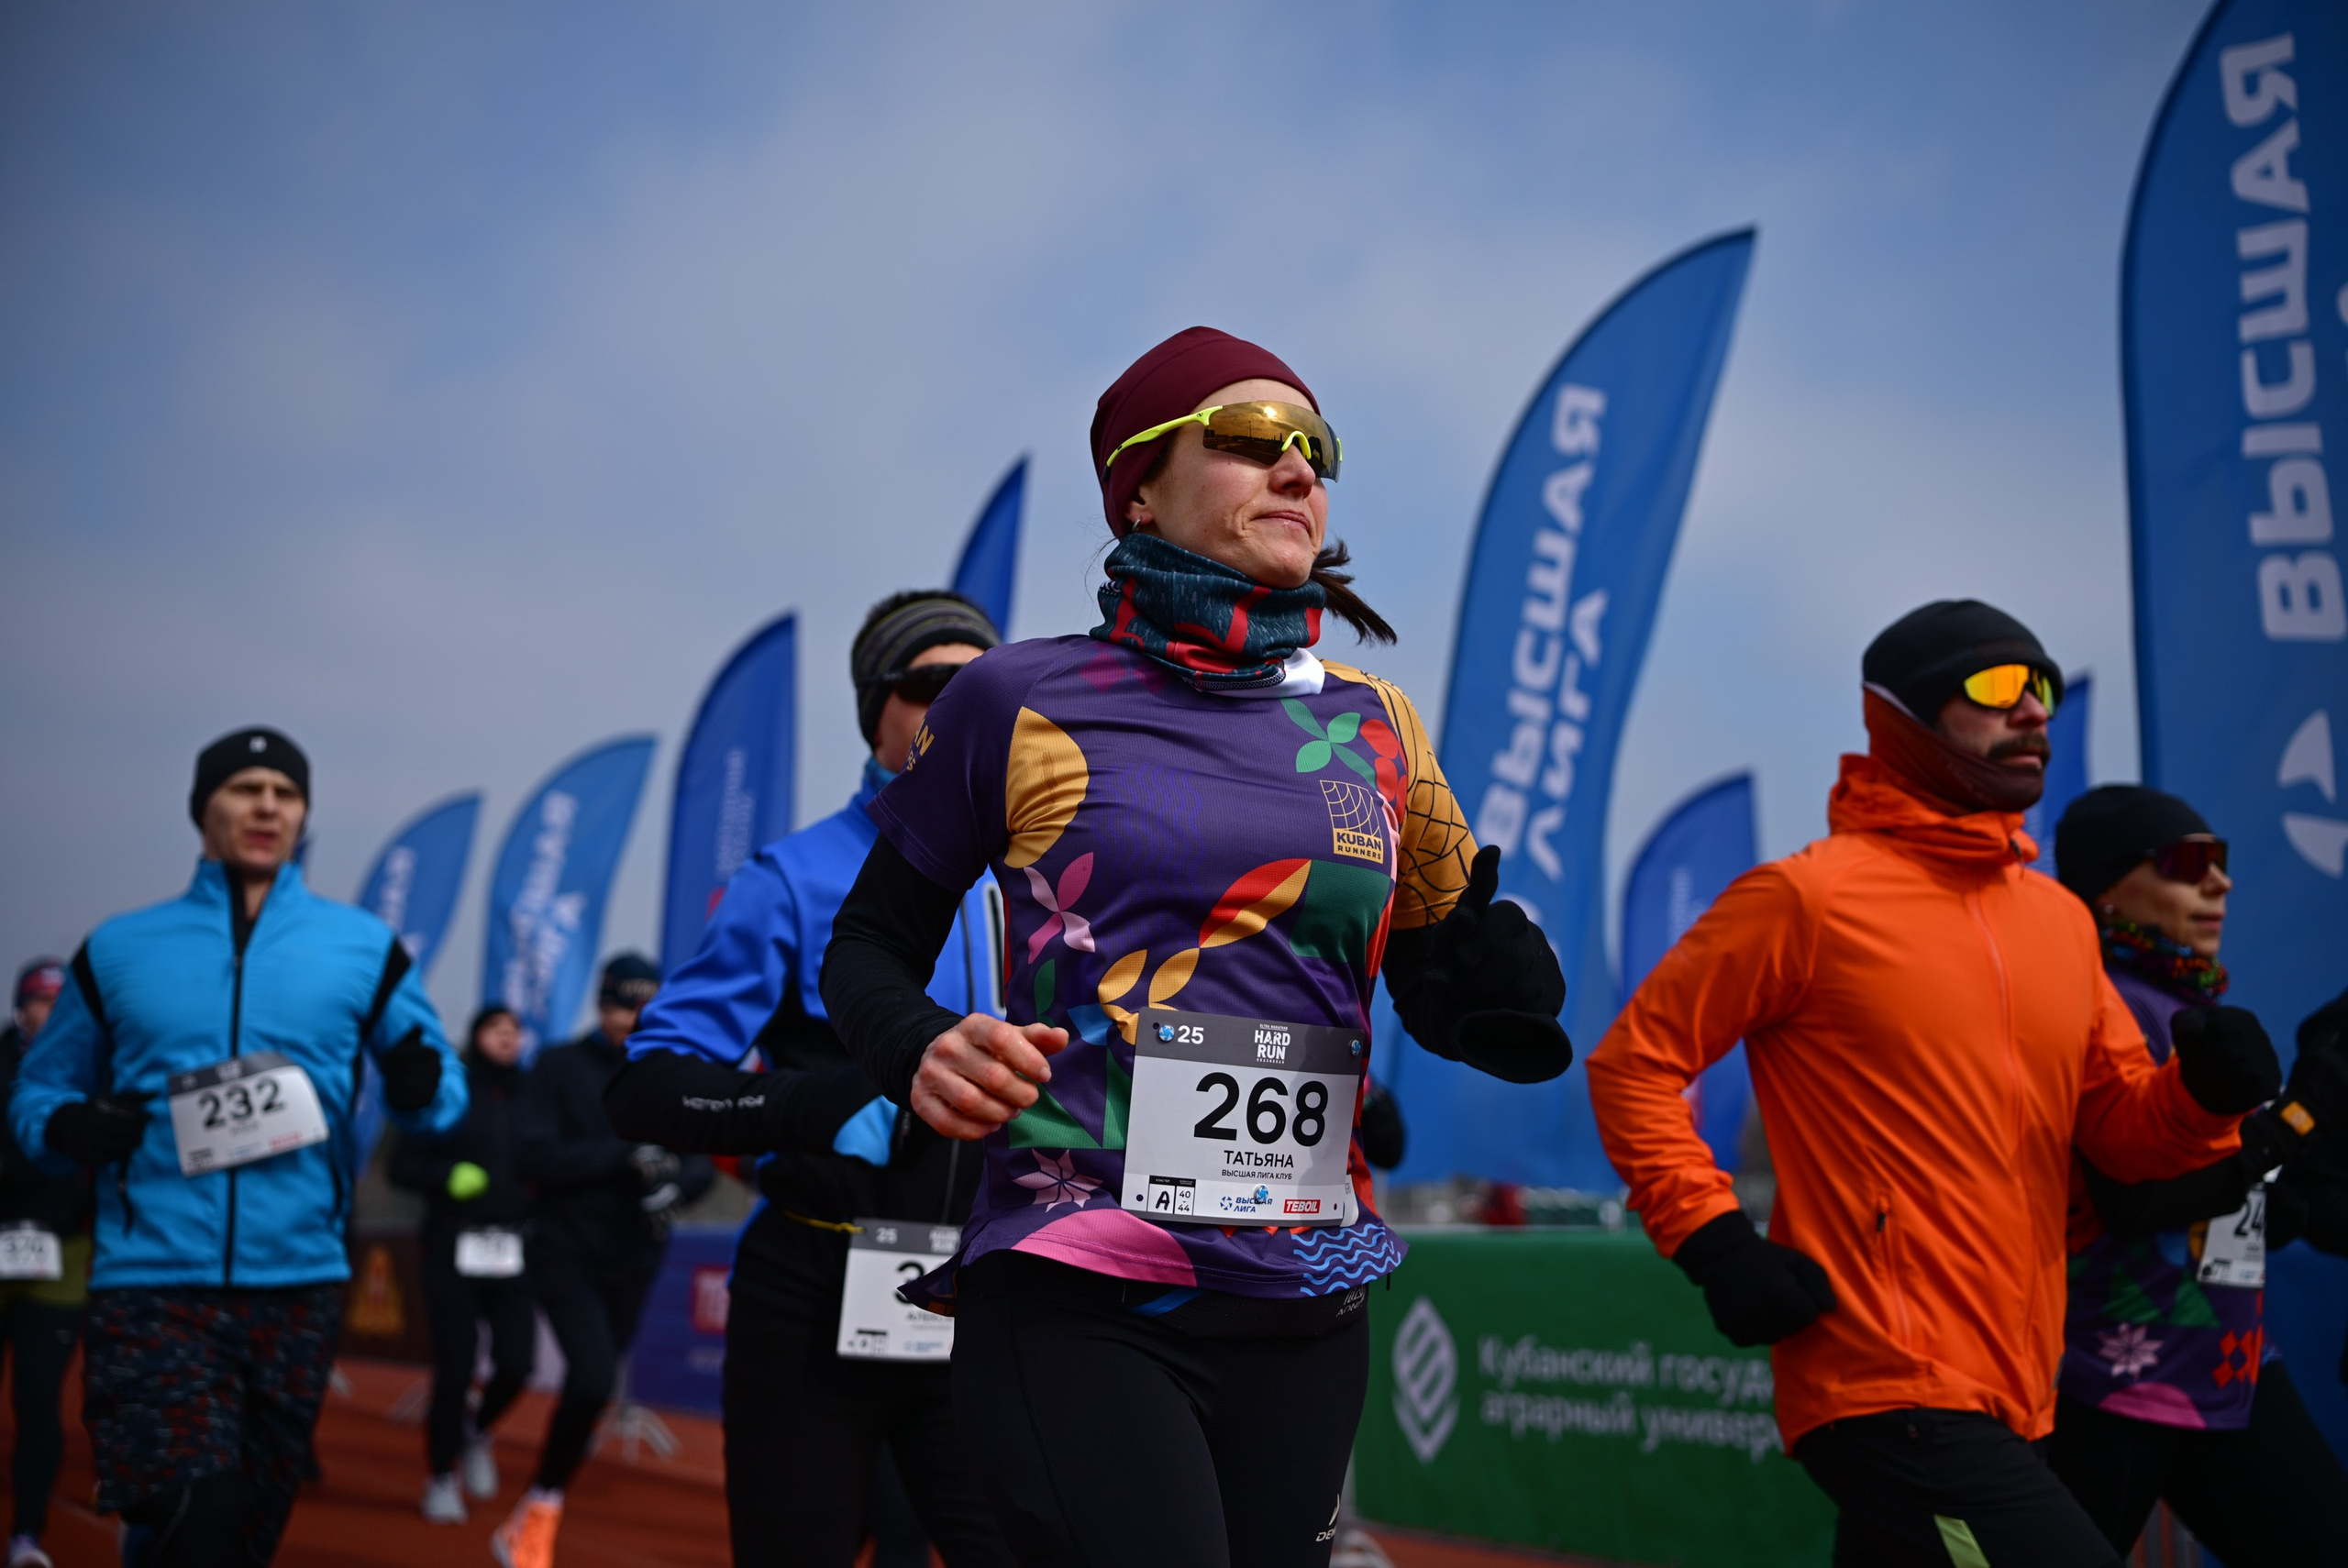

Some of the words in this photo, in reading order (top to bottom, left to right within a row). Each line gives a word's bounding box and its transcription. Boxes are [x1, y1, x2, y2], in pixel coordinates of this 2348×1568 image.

[2220, 31, 2347, 640] ВЫСШАЯ
[1474, 381, 1608, 860] ВЫСШАЯ
[1525, 584, 1611, 882] ЛИГА
[1336, 832, 1381, 851] KUBAN
[1337, 845, 1381, 860] RUNNERS
[1178, 1025, 1204, 1044] 25
[1254, 1029, 1291, 1046] HARD
[1257, 1043, 1286, 1060] RUN
[197, 1078, 286, 1130] 232
[1193, 1071, 1329, 1147] 268
[1224, 1150, 1294, 1168] ТАТЬЯНА
[1221, 1169, 1256, 1178] ВЫСШАЯ
[1257, 1171, 1274, 1179] ЛИГА
[1275, 1172, 1292, 1180] КЛУБ
[1179, 1190, 1191, 1198] 40
[1178, 1203, 1190, 1212] 44
[1234, 1205, 1256, 1213] ЛИГА
[1286, 1200, 1319, 1212] TEBOIL
[875, 1226, 898, 1244] 25
[1478, 1333, 1656, 1389] Кубанский
[1479, 1390, 1637, 1443] аграрный
[1315, 1528, 1336, 1542] DE
